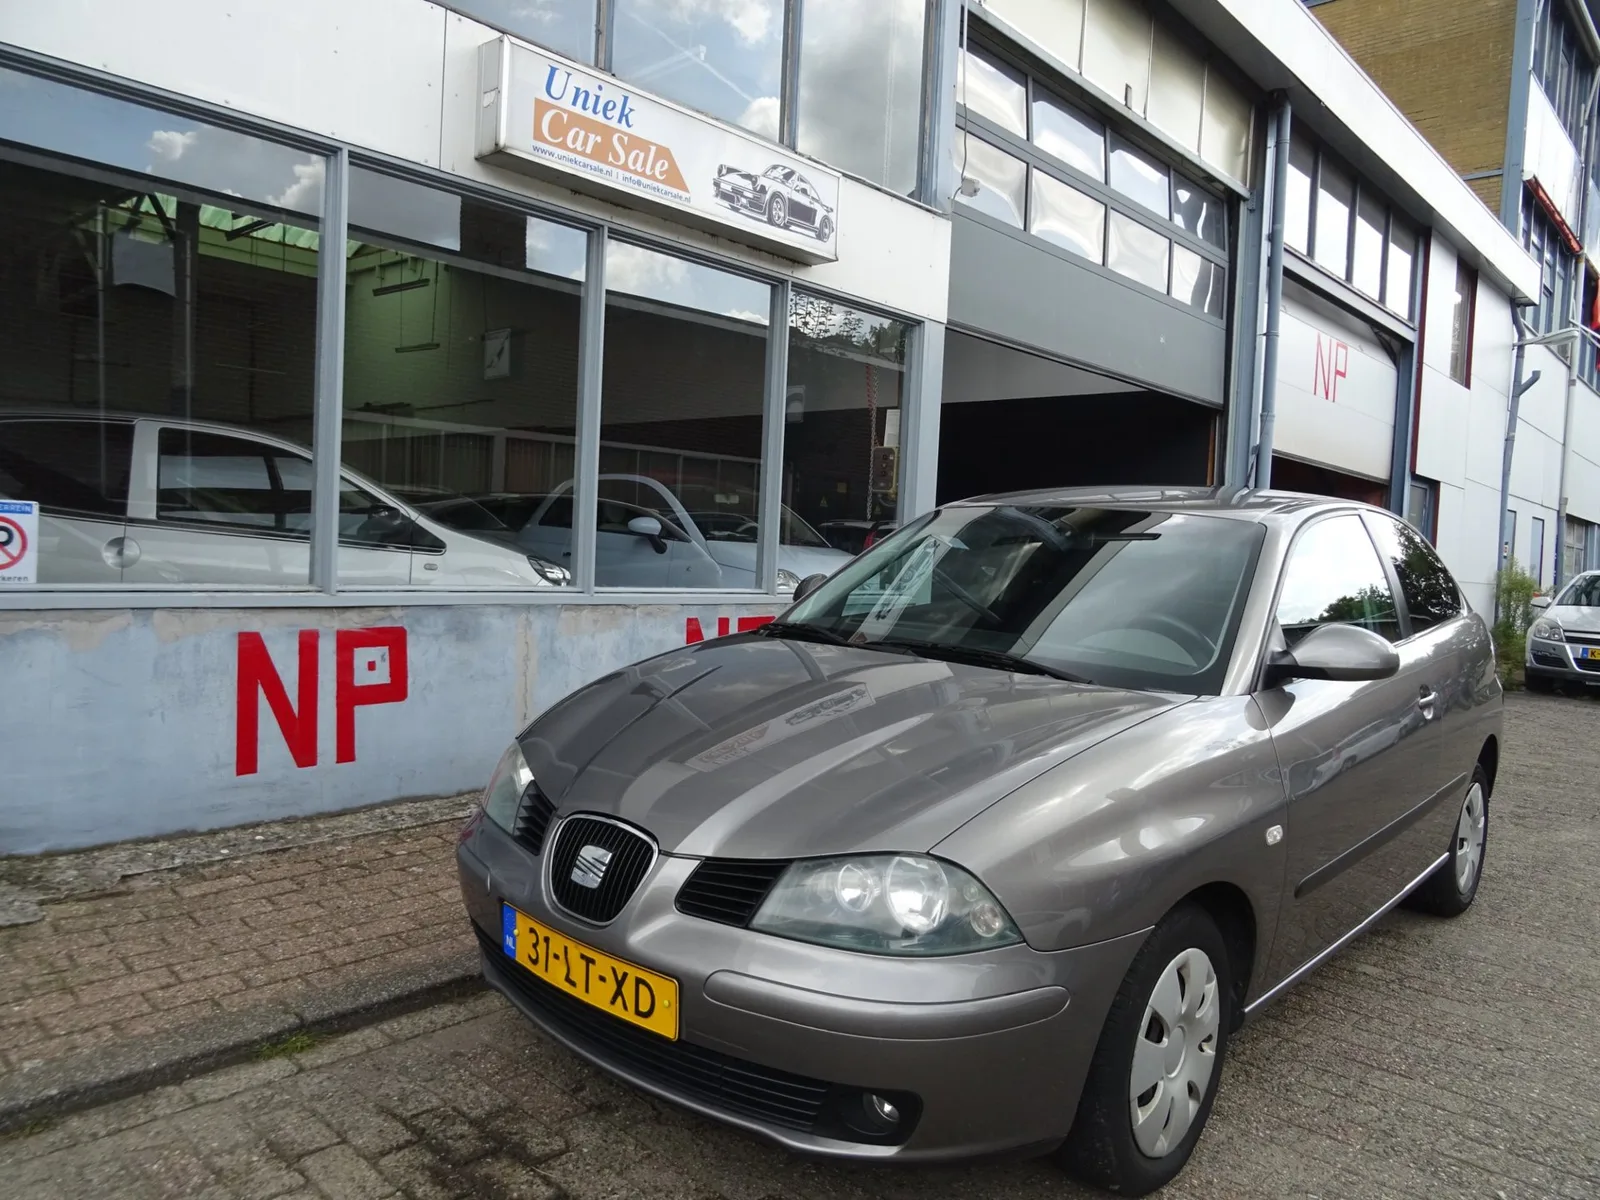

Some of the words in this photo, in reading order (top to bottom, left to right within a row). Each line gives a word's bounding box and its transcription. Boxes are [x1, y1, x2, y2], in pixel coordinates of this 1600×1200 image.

[545, 64, 636, 128] Uniek
[532, 144, 613, 178] www.uniekcarsale.nl
[622, 173, 692, 204] info@uniekcarsale.nl
[541, 108, 602, 155] Car
[608, 132, 669, 180] Sale
[1313, 331, 1349, 403] NP
[236, 626, 408, 777] NP
[506, 934, 516, 950] NL
[527, 926, 656, 1019] 31-LT-XD
